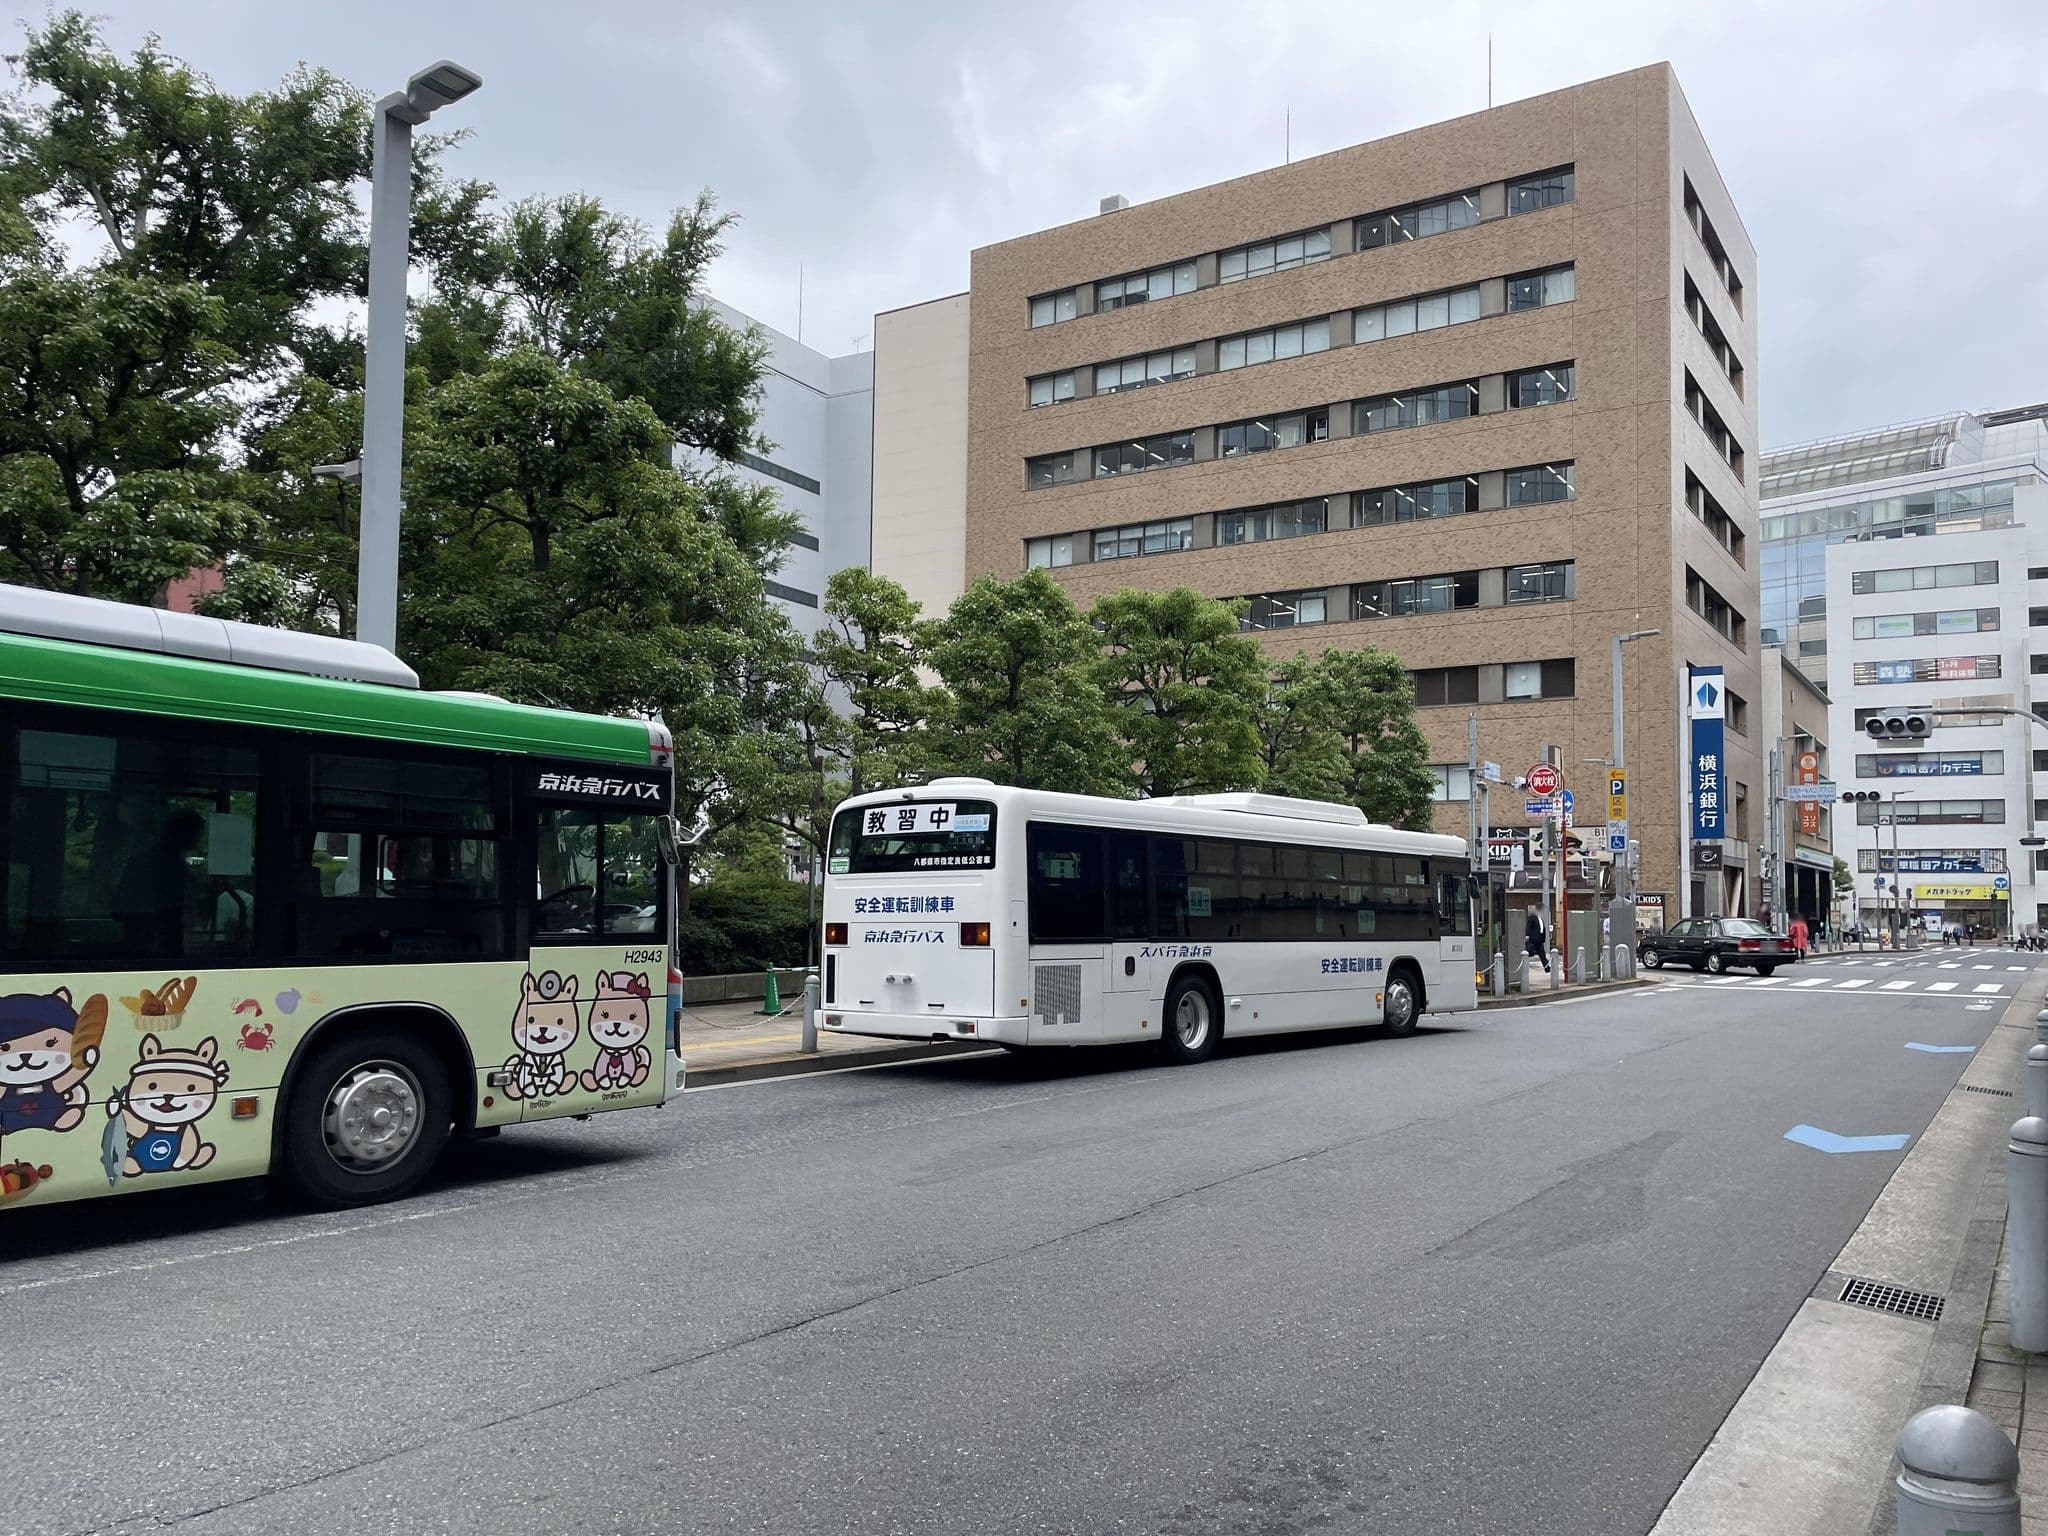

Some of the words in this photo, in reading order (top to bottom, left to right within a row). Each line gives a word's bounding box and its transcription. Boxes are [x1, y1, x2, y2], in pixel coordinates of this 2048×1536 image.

[537, 773, 661, 800] 京浜急行バス
[1533, 775, 1555, 787] 消火栓
[1698, 754, 1718, 828] 横浜銀行
[867, 806, 950, 834] 教習中
[1488, 844, 1511, 856] KID
[1898, 860, 1981, 871] 早稲田アカ
[854, 895, 955, 914] 安全運転訓練車
[863, 930, 945, 943] 京浜急行バス
[624, 950, 663, 964] H2943
[1321, 957, 1383, 974] 安全運転訓練車
